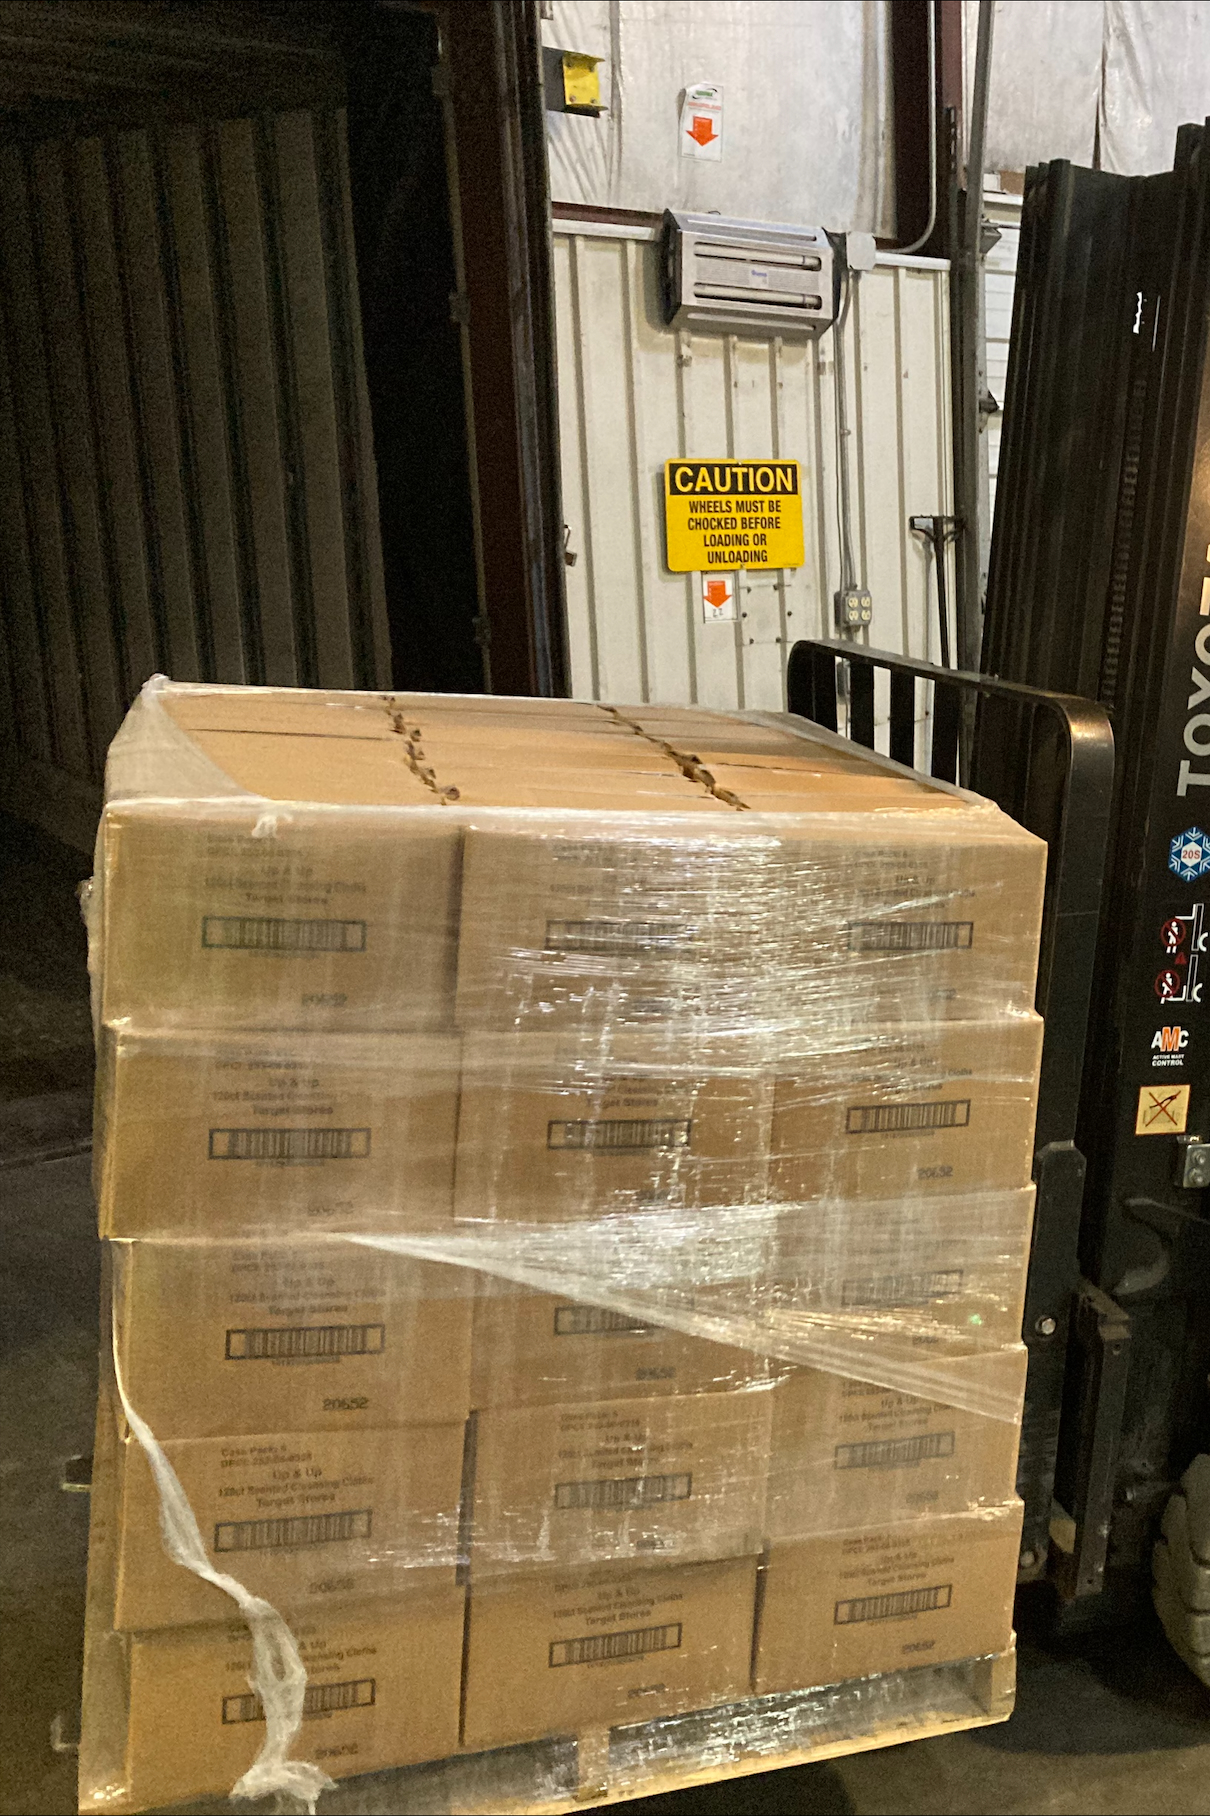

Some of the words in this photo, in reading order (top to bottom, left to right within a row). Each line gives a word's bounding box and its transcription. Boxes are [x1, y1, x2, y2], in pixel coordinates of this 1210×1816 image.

[674, 467, 793, 492] CAUTION
[688, 500, 733, 514] WHEELS
[735, 500, 765, 513] MUST
[768, 499, 782, 513] BE
[687, 517, 738, 531] CHOCKED
[740, 516, 782, 530] BEFORE
[703, 533, 750, 547] LOADING
[752, 533, 768, 546] OR
[707, 549, 769, 564] UNLOADING
[1181, 850, 1201, 860] 20S
[1150, 1026, 1190, 1052] AMC
[1151, 1059, 1184, 1067] CONTROL
